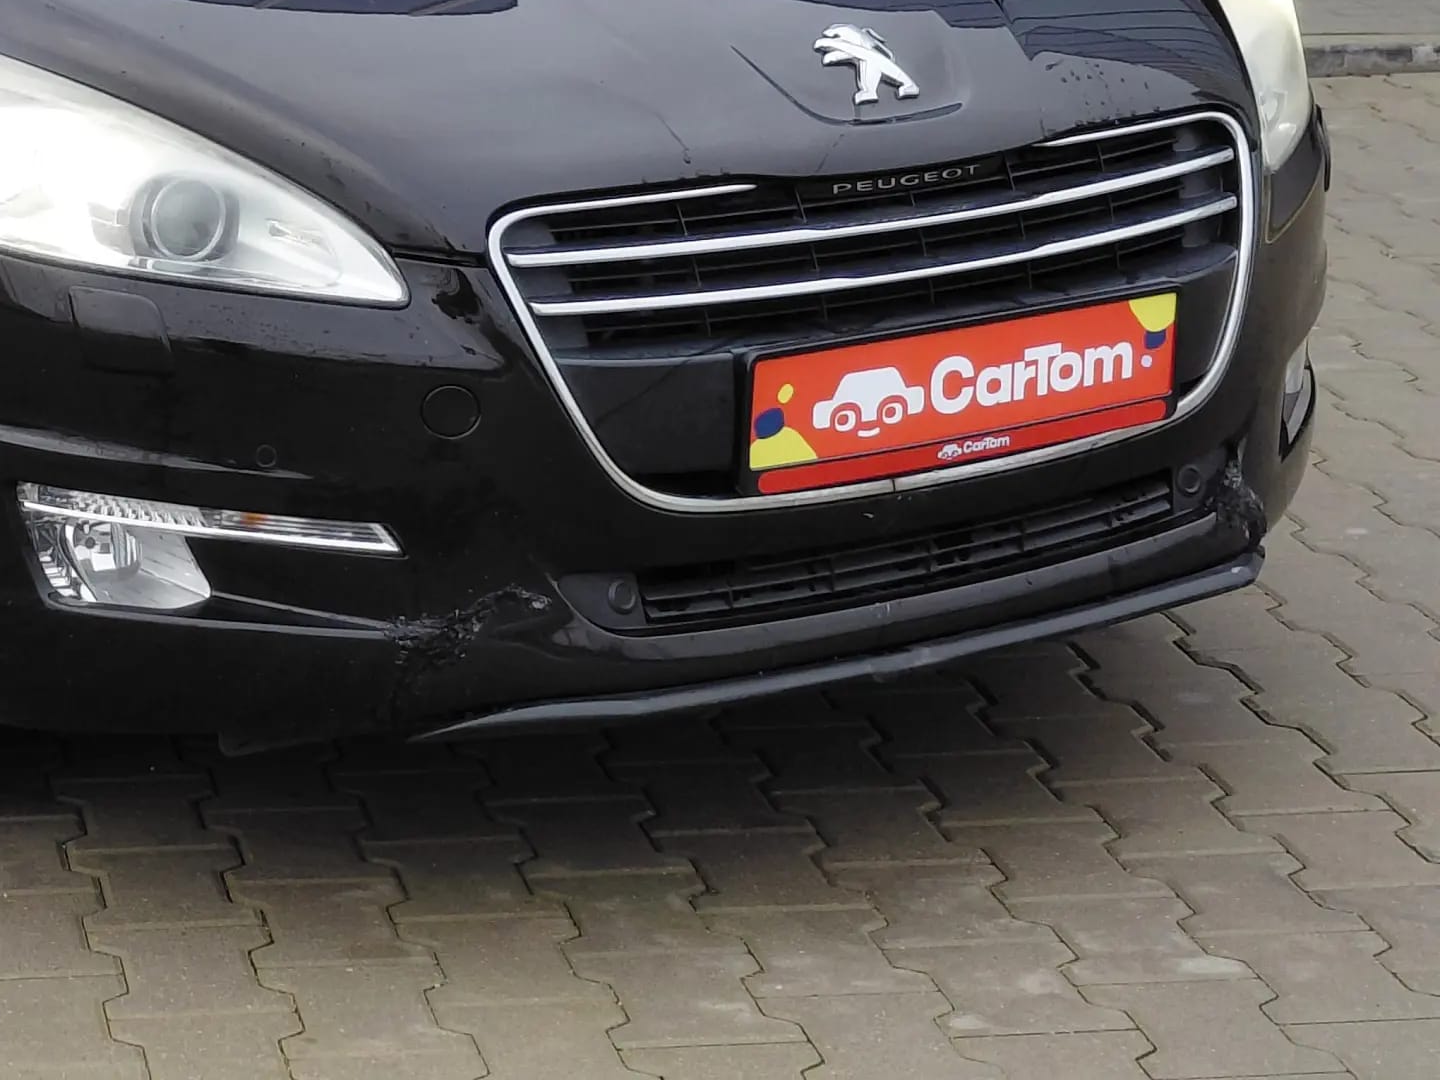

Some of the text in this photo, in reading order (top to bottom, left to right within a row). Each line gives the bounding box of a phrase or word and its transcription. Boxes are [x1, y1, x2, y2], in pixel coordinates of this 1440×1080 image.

[832, 164, 981, 195] PEUGEOT
[930, 341, 1133, 415] CarTom
[963, 435, 1010, 454] CarTom
